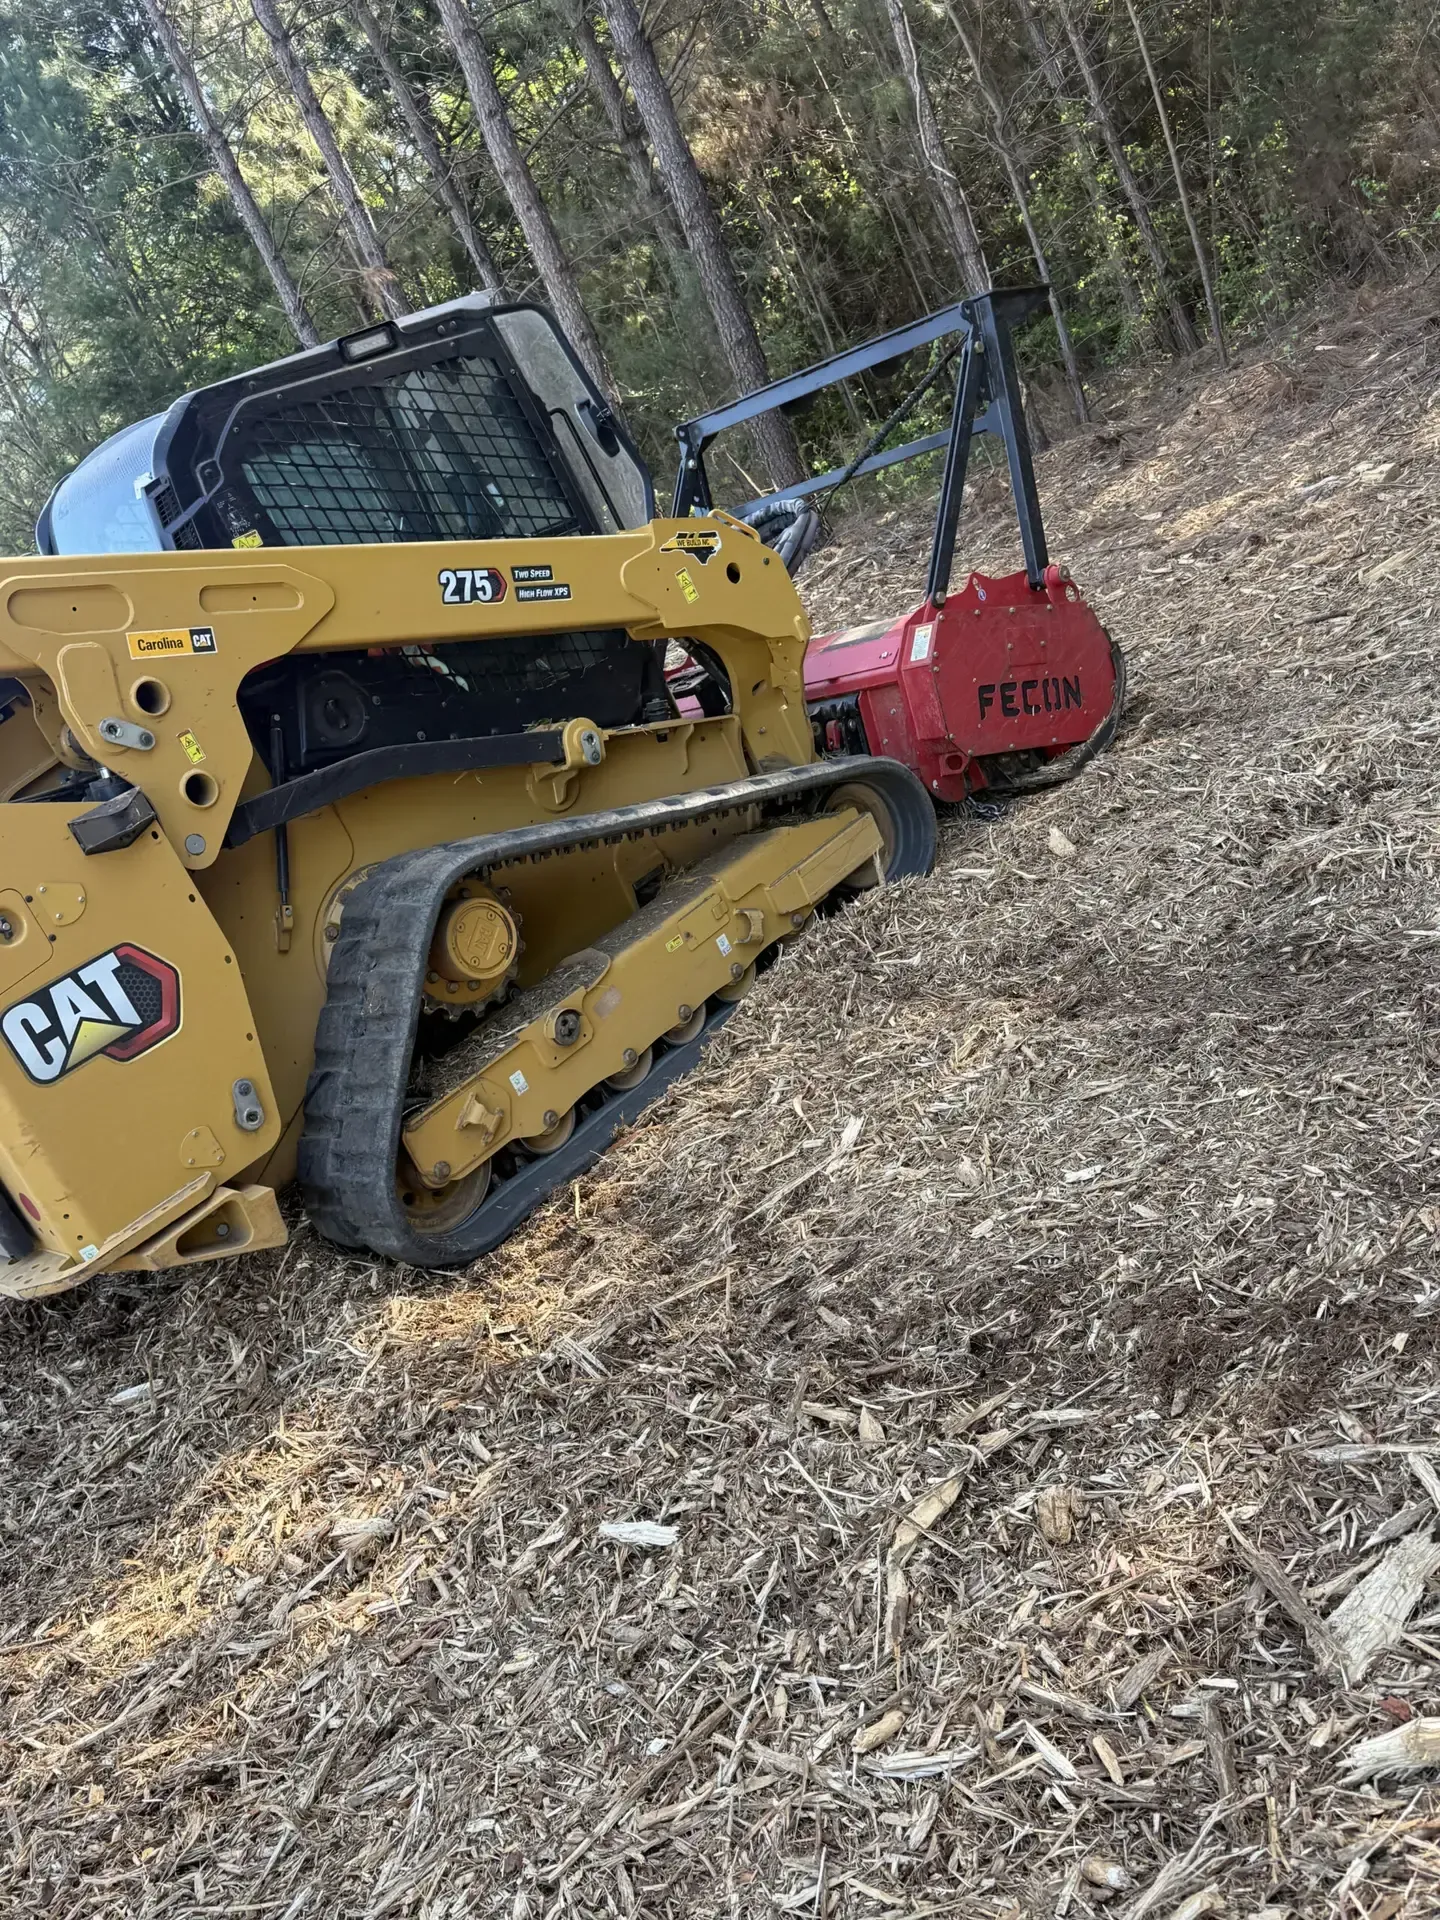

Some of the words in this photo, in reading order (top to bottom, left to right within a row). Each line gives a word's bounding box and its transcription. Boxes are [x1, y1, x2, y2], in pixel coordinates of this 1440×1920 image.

[687, 539, 702, 547] BUILD
[439, 569, 493, 602] 275
[554, 586, 568, 597] XPS
[137, 637, 184, 651] Carolina
[192, 634, 212, 647] CAT
[978, 675, 1082, 720] FECON
[2, 951, 143, 1080] CAT
